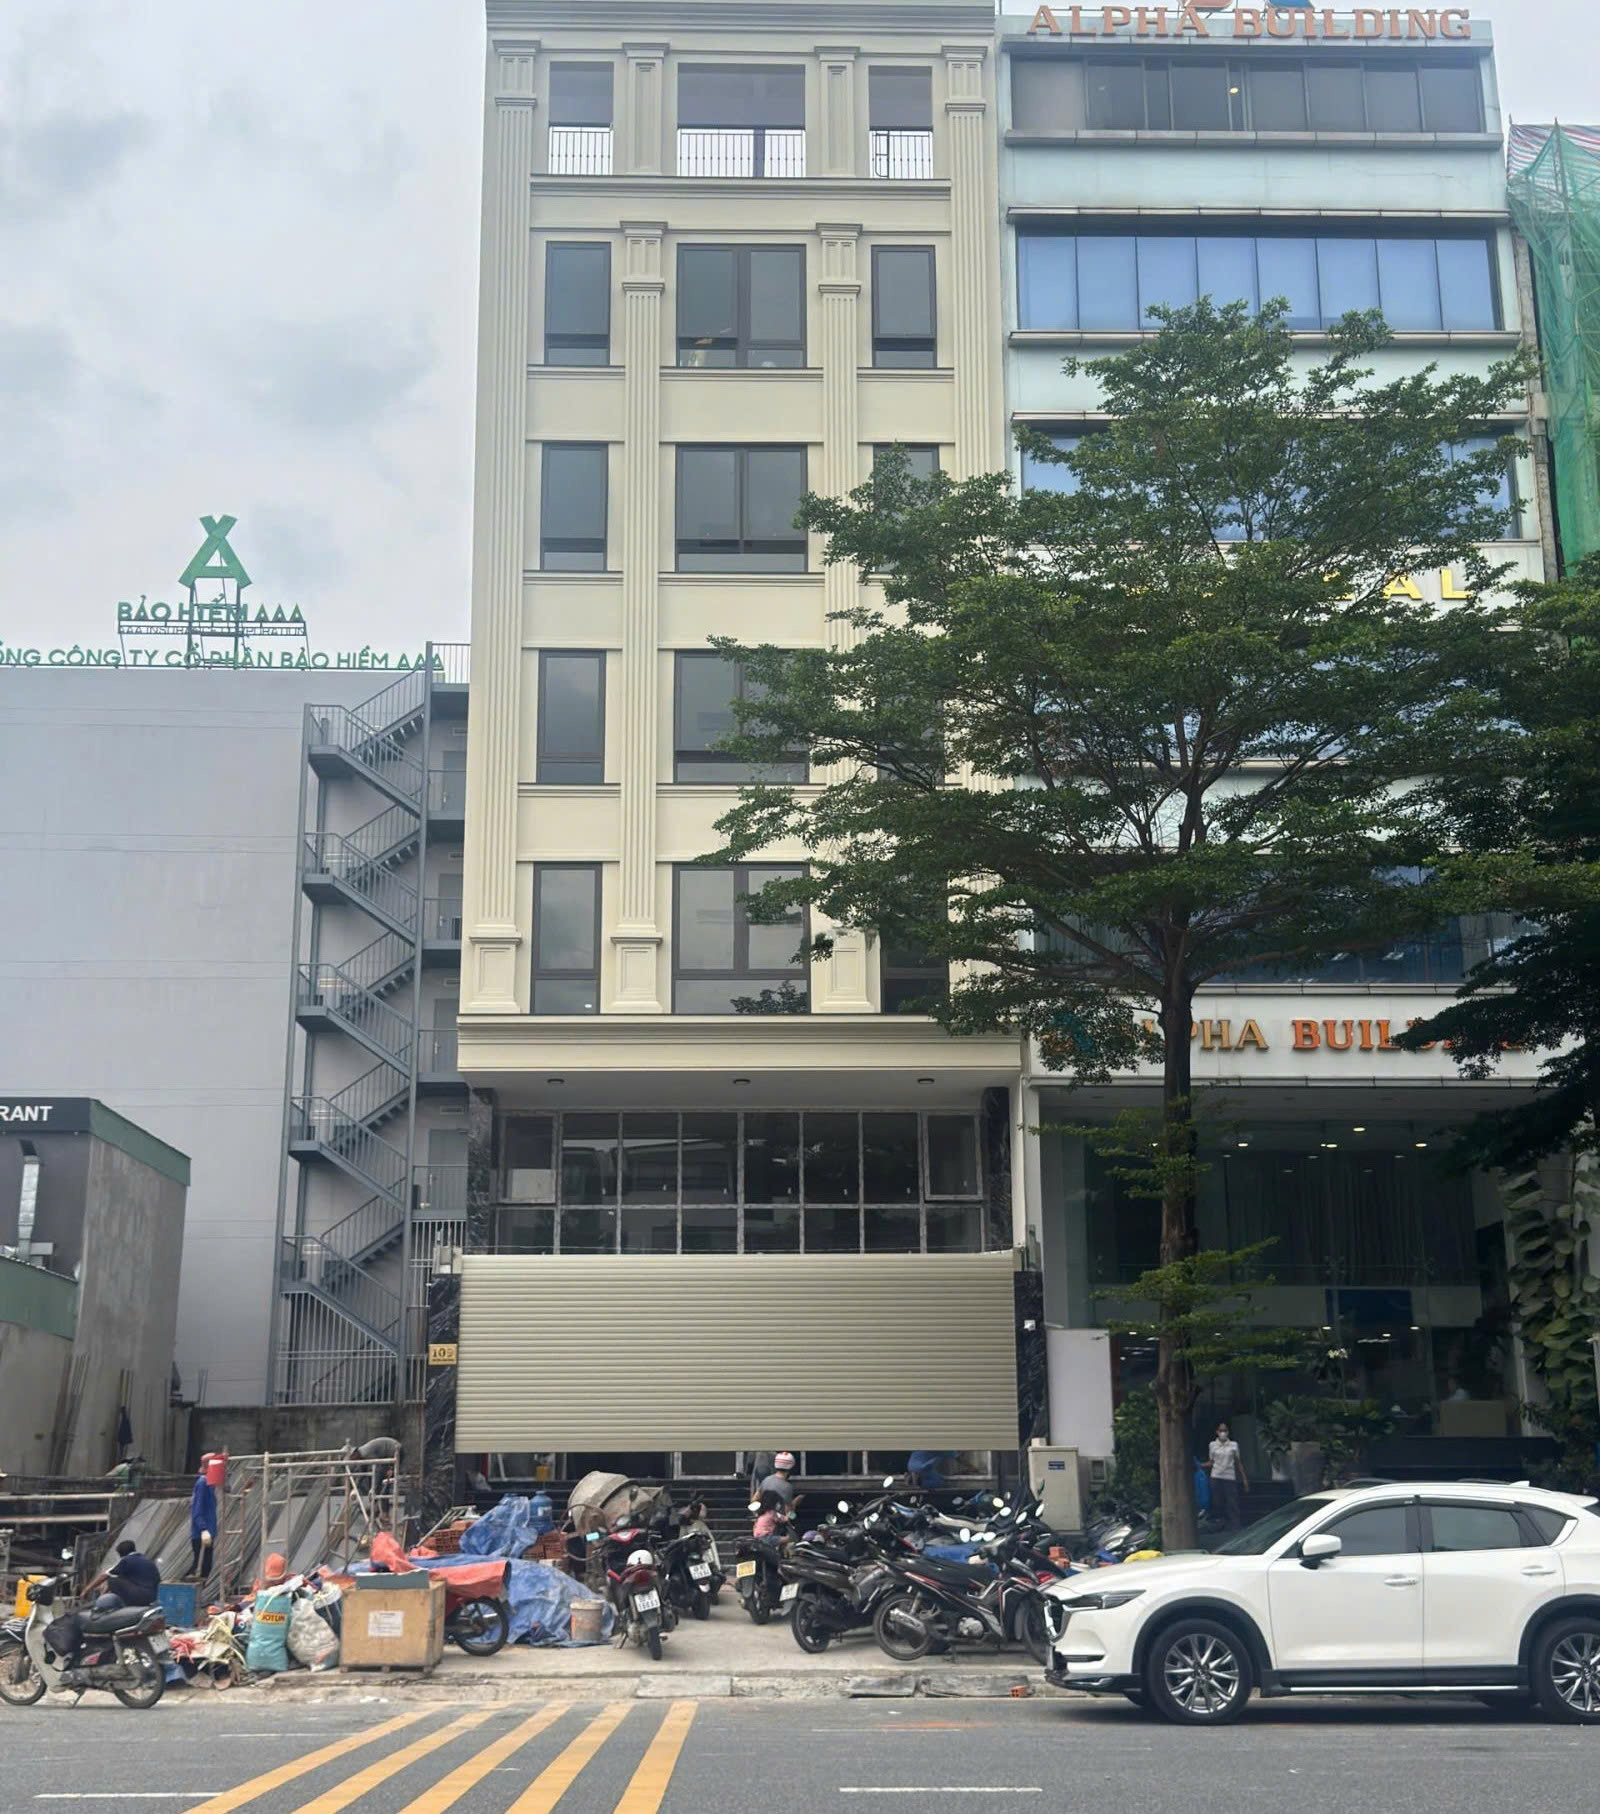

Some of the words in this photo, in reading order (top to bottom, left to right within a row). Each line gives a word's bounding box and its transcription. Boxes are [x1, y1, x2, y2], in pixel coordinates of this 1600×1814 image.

[1026, 5, 1210, 37] ALPHA
[1234, 7, 1473, 40] BUILDING
[118, 595, 171, 621] BẢO
[255, 603, 305, 622] AAA
[48, 645, 122, 666] CÔNG
[130, 649, 158, 666] TY
[165, 642, 201, 667] CỔ
[281, 646, 329, 668] BẢO
[396, 653, 444, 670] AAA
